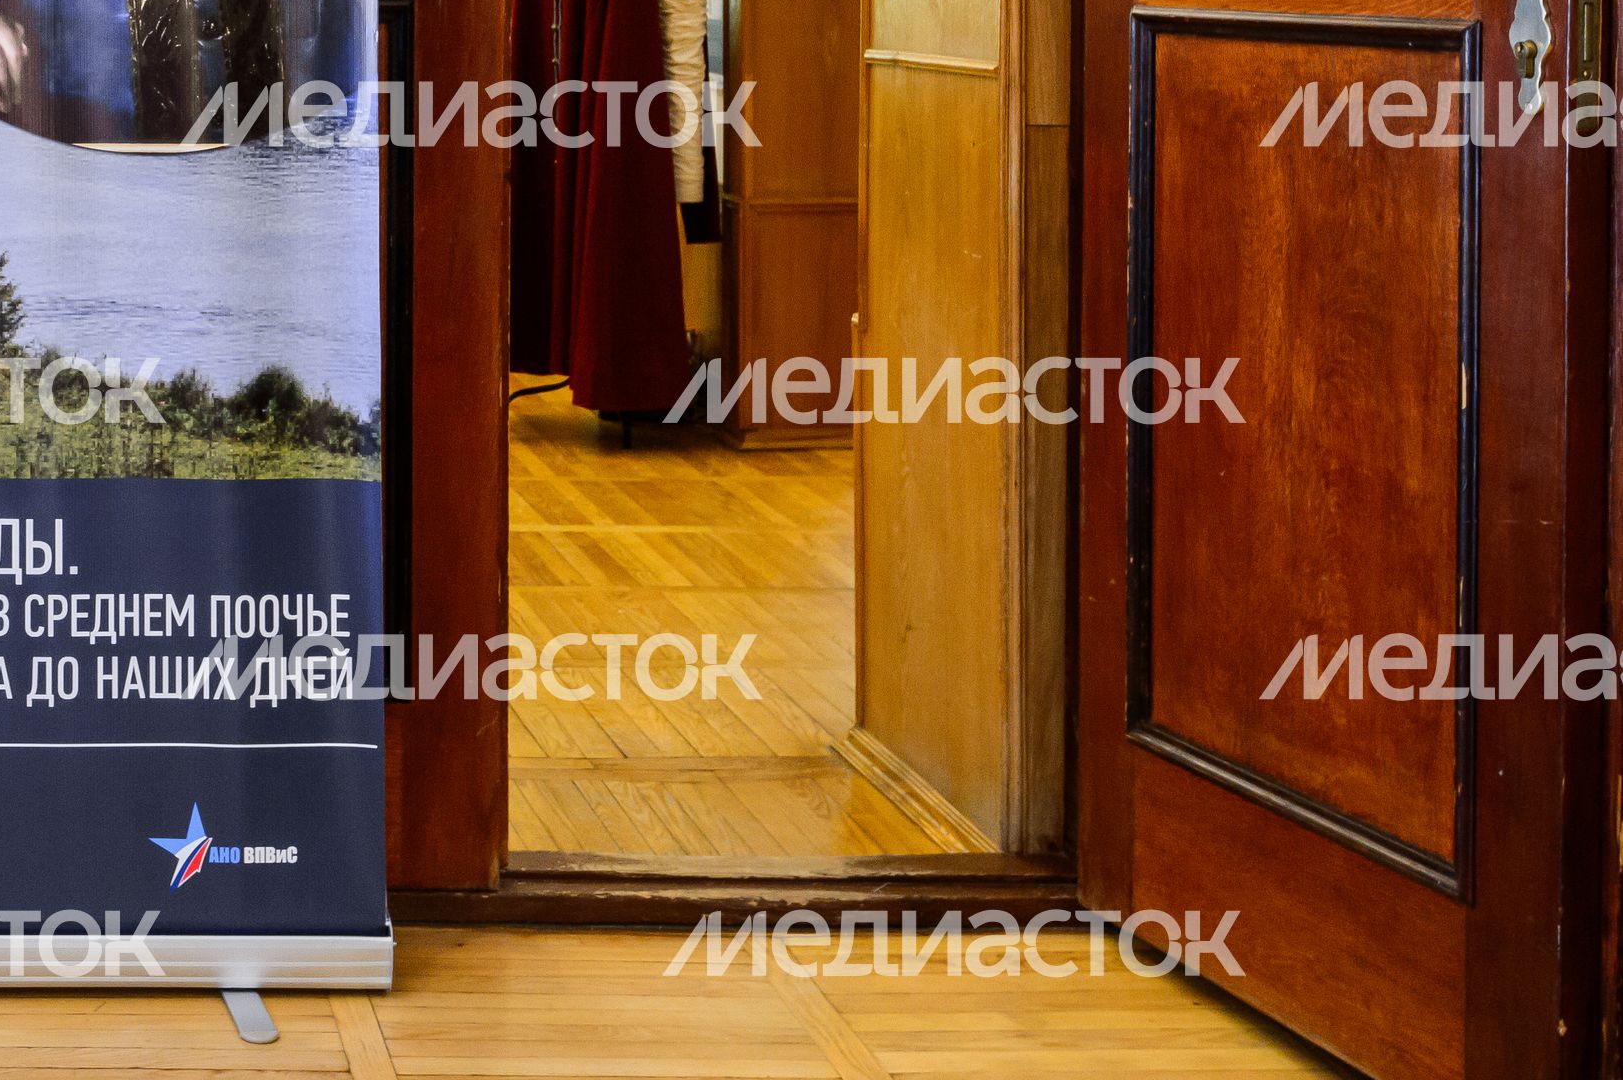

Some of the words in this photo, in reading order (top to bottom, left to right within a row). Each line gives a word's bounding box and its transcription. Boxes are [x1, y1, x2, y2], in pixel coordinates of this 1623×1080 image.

[24, 593, 195, 645] СРЕДНЕМ
[210, 594, 351, 638] ПООЧЬЕ
[27, 655, 80, 708] ДО
[97, 655, 236, 700] НАШИХ
[250, 647, 354, 708] ДНЕЙ
[208, 846, 241, 864] АНО
